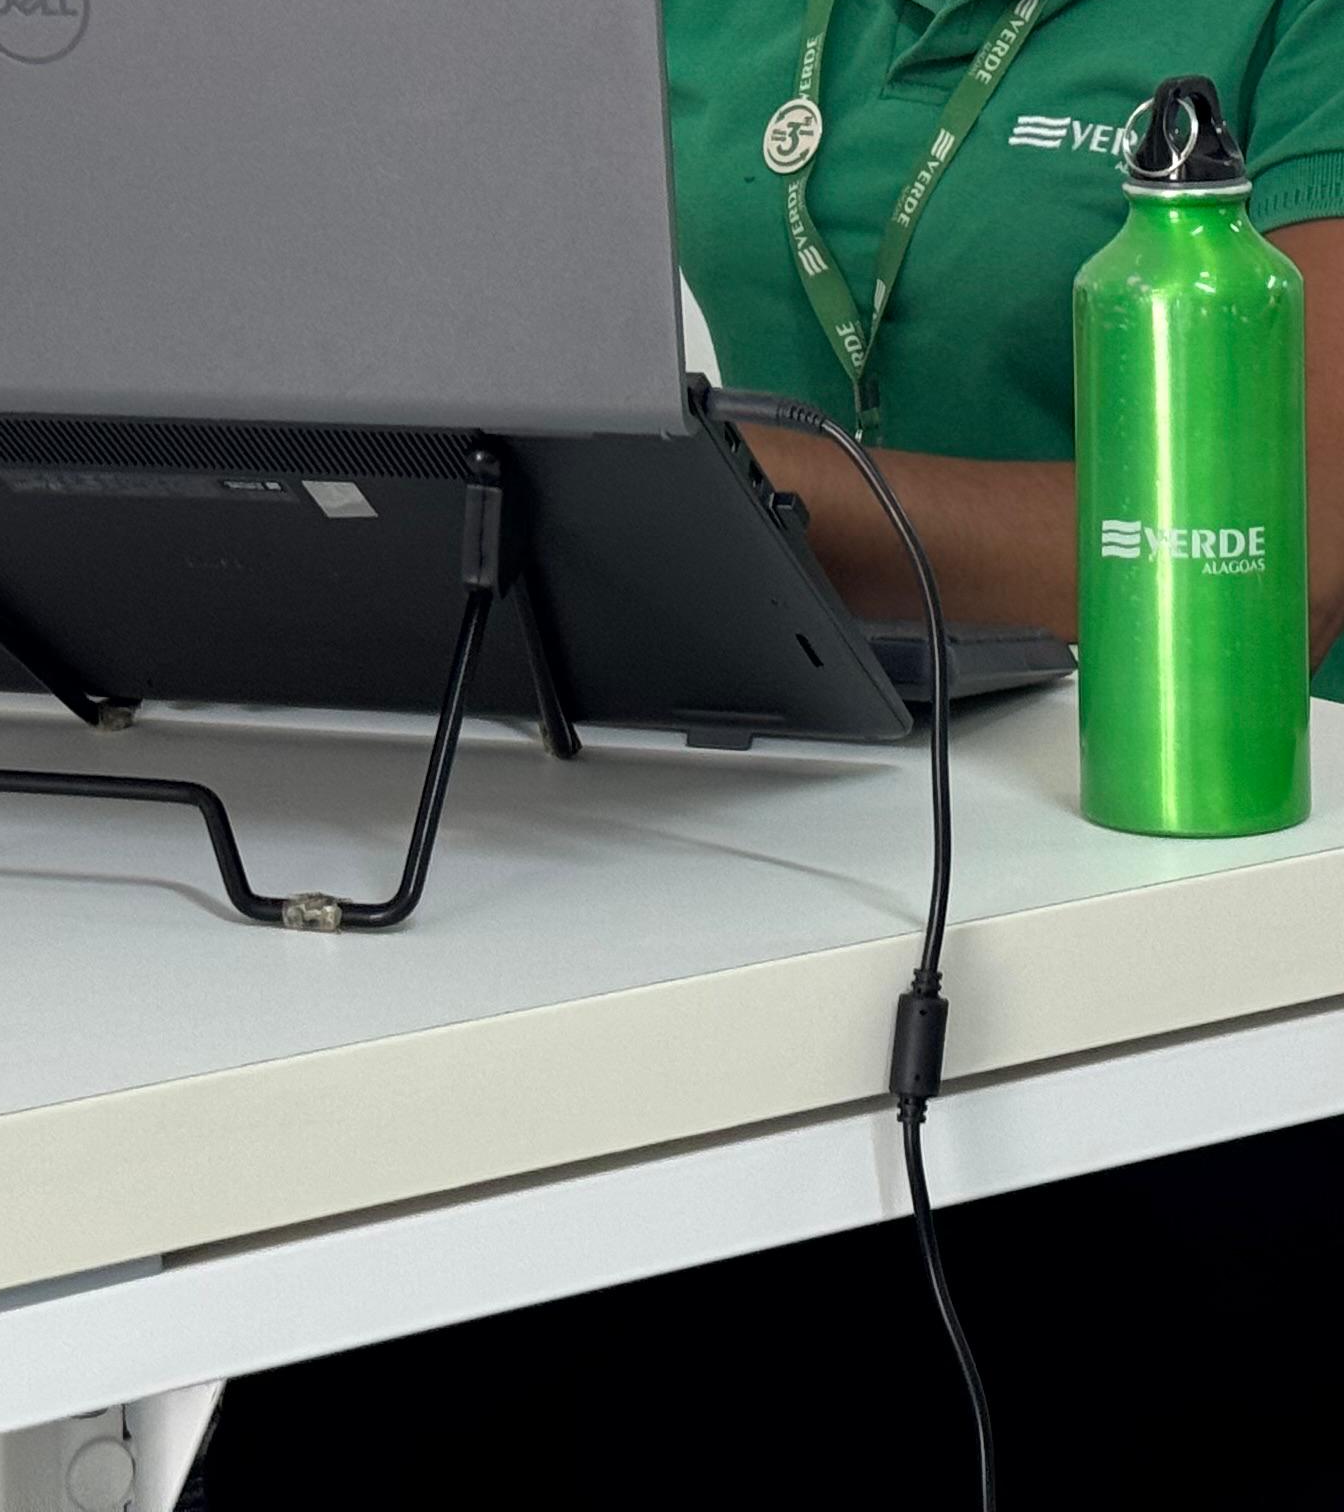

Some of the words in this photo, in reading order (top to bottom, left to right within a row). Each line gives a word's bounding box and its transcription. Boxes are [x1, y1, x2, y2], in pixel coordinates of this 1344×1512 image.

[976, 17, 1025, 85] VERDE
[1071, 120, 1139, 156] VER
[787, 180, 807, 250] VERDE
[897, 160, 940, 228] VERDE
[835, 321, 865, 369] RDE
[1144, 527, 1266, 563] VERDE
[1202, 559, 1266, 575] ALAGOAS
